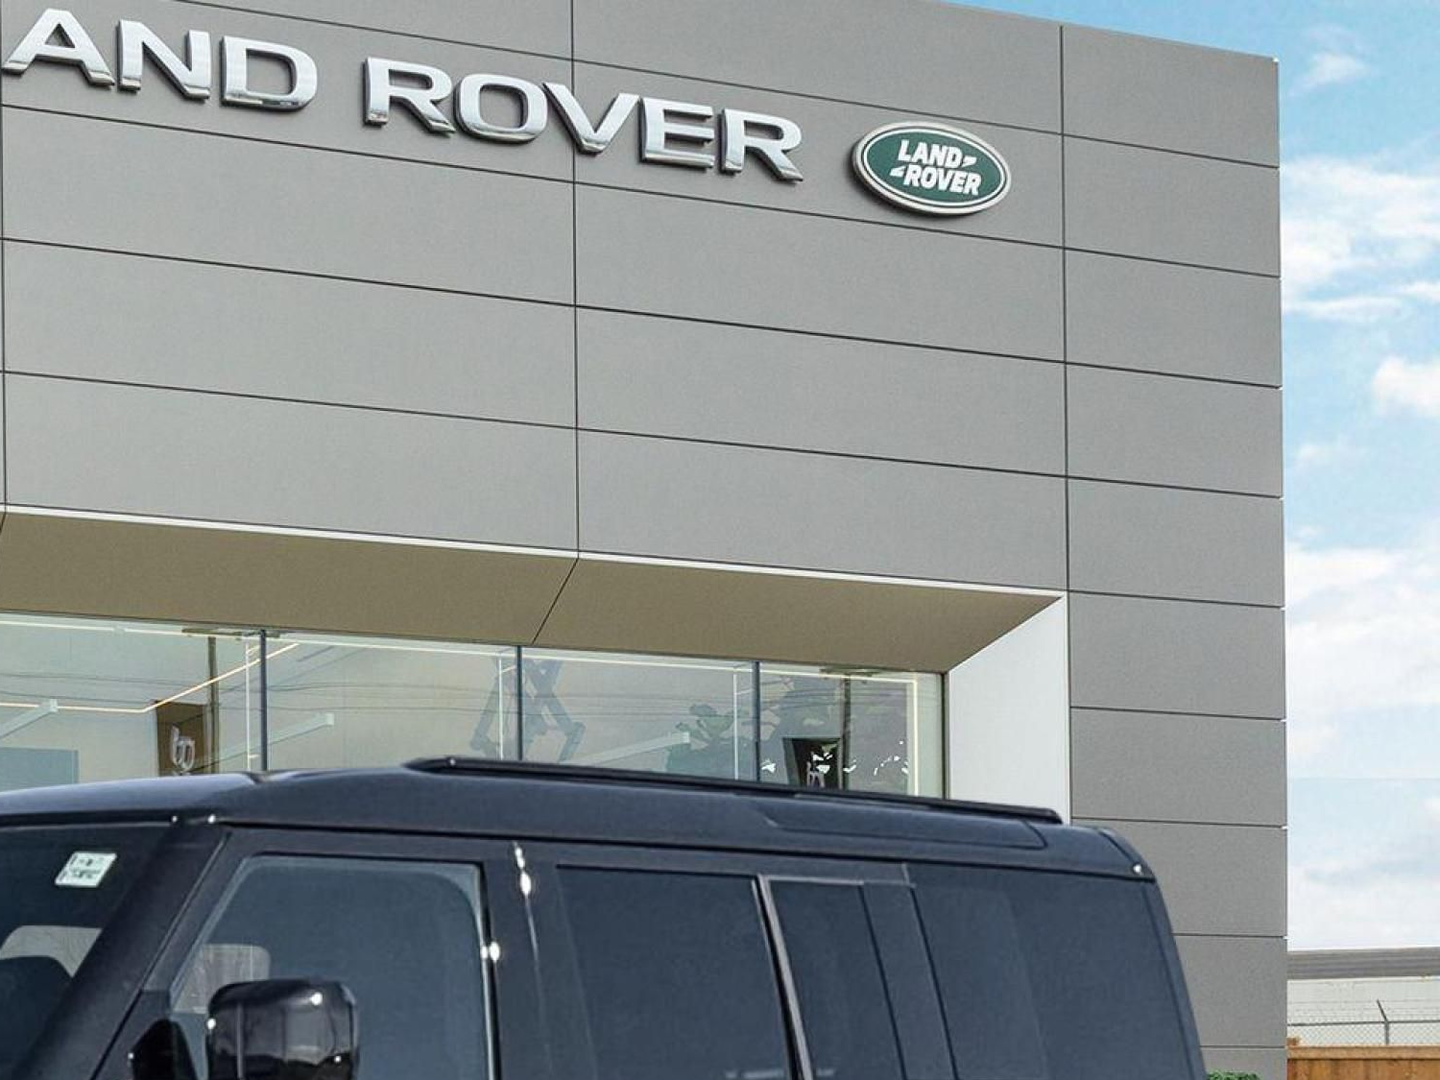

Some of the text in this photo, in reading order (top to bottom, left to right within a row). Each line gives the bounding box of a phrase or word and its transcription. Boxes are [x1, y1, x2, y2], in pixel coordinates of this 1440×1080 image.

[362, 56, 804, 182] ROVER
[897, 139, 963, 168] LAND
[902, 164, 982, 196] ROVER
